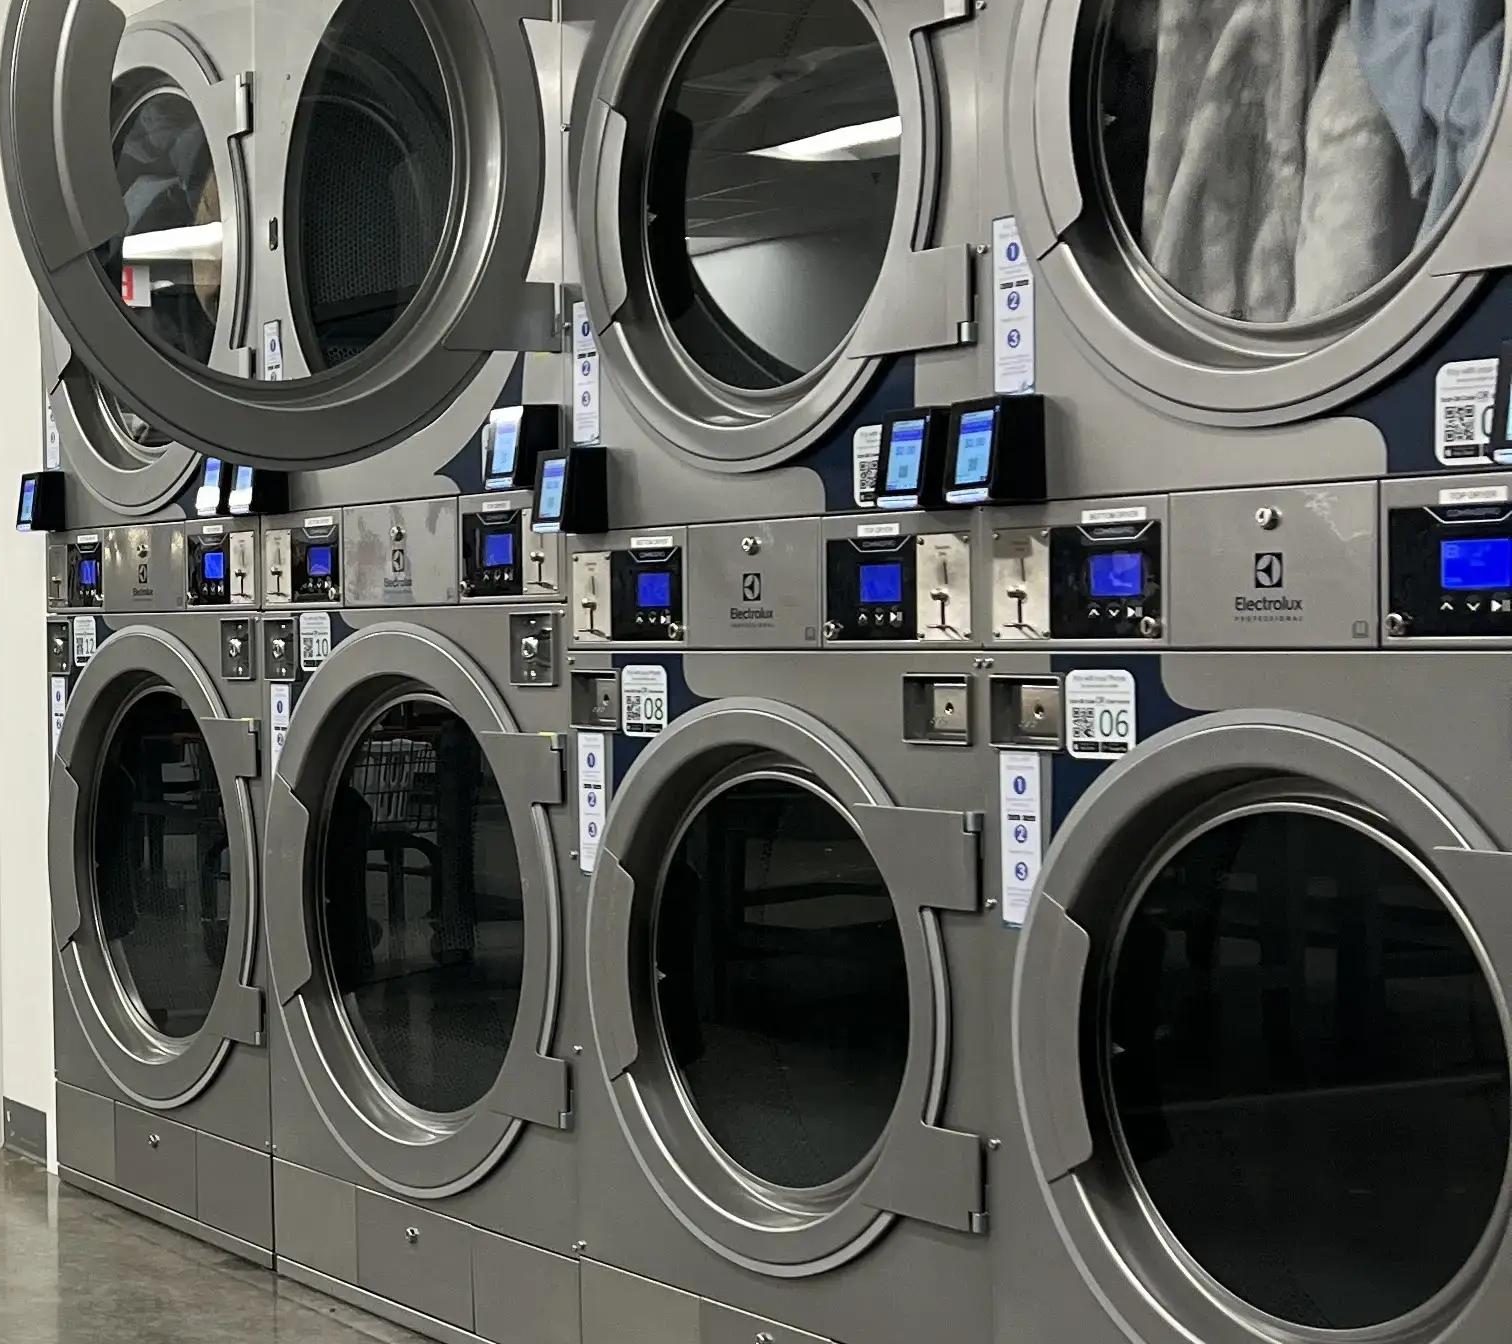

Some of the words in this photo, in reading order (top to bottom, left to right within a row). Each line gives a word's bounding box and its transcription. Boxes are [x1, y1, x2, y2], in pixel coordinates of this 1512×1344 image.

[1235, 596, 1303, 611] Electrolux
[730, 607, 774, 619] Electrolux
[85, 638, 94, 654] 12
[316, 637, 329, 656] 10
[644, 697, 663, 720] 08
[1099, 709, 1129, 738] 06
